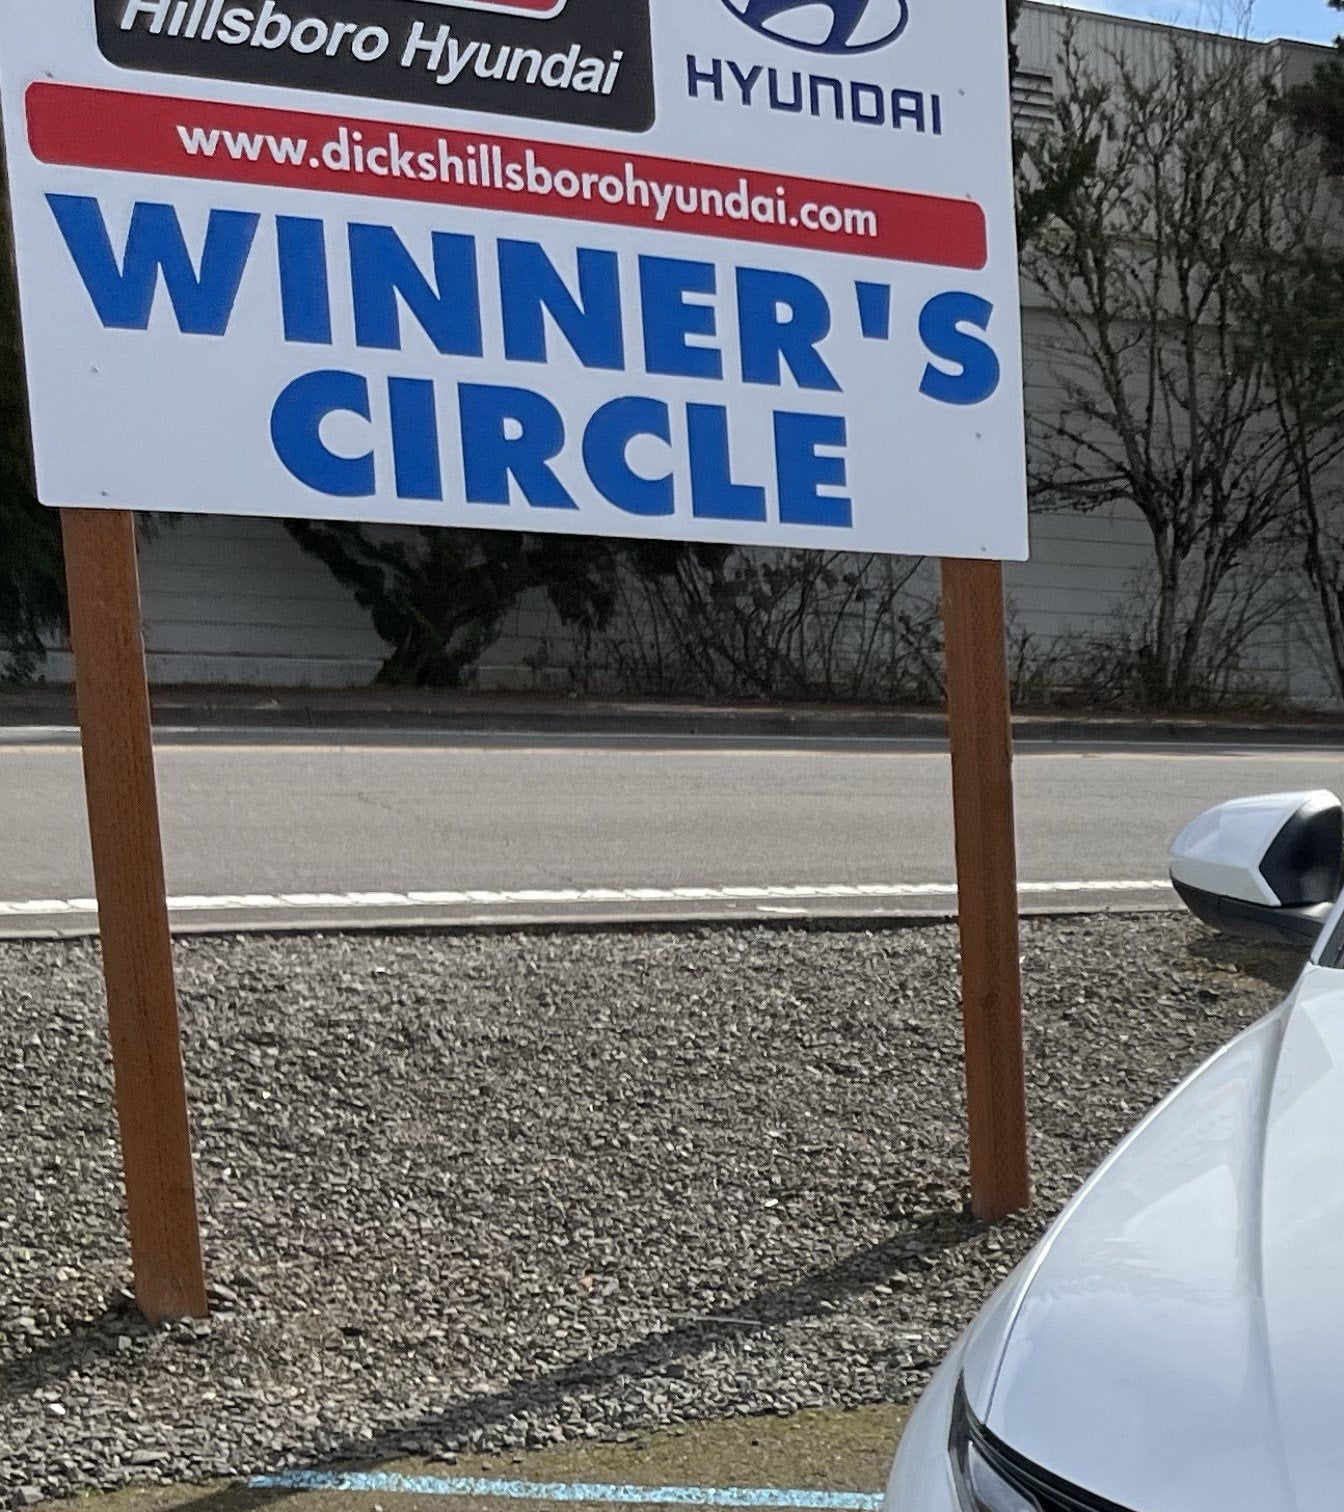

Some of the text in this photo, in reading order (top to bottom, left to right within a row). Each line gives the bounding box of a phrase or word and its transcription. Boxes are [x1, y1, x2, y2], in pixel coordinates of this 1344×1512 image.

[119, 0, 624, 95] Hillsboro Hyundai
[686, 54, 942, 136] HYUNDAI
[176, 120, 879, 239] www.dickshillsborohyundai.com
[44, 193, 1001, 406] WINNER'S
[270, 368, 854, 528] CIRCLE
